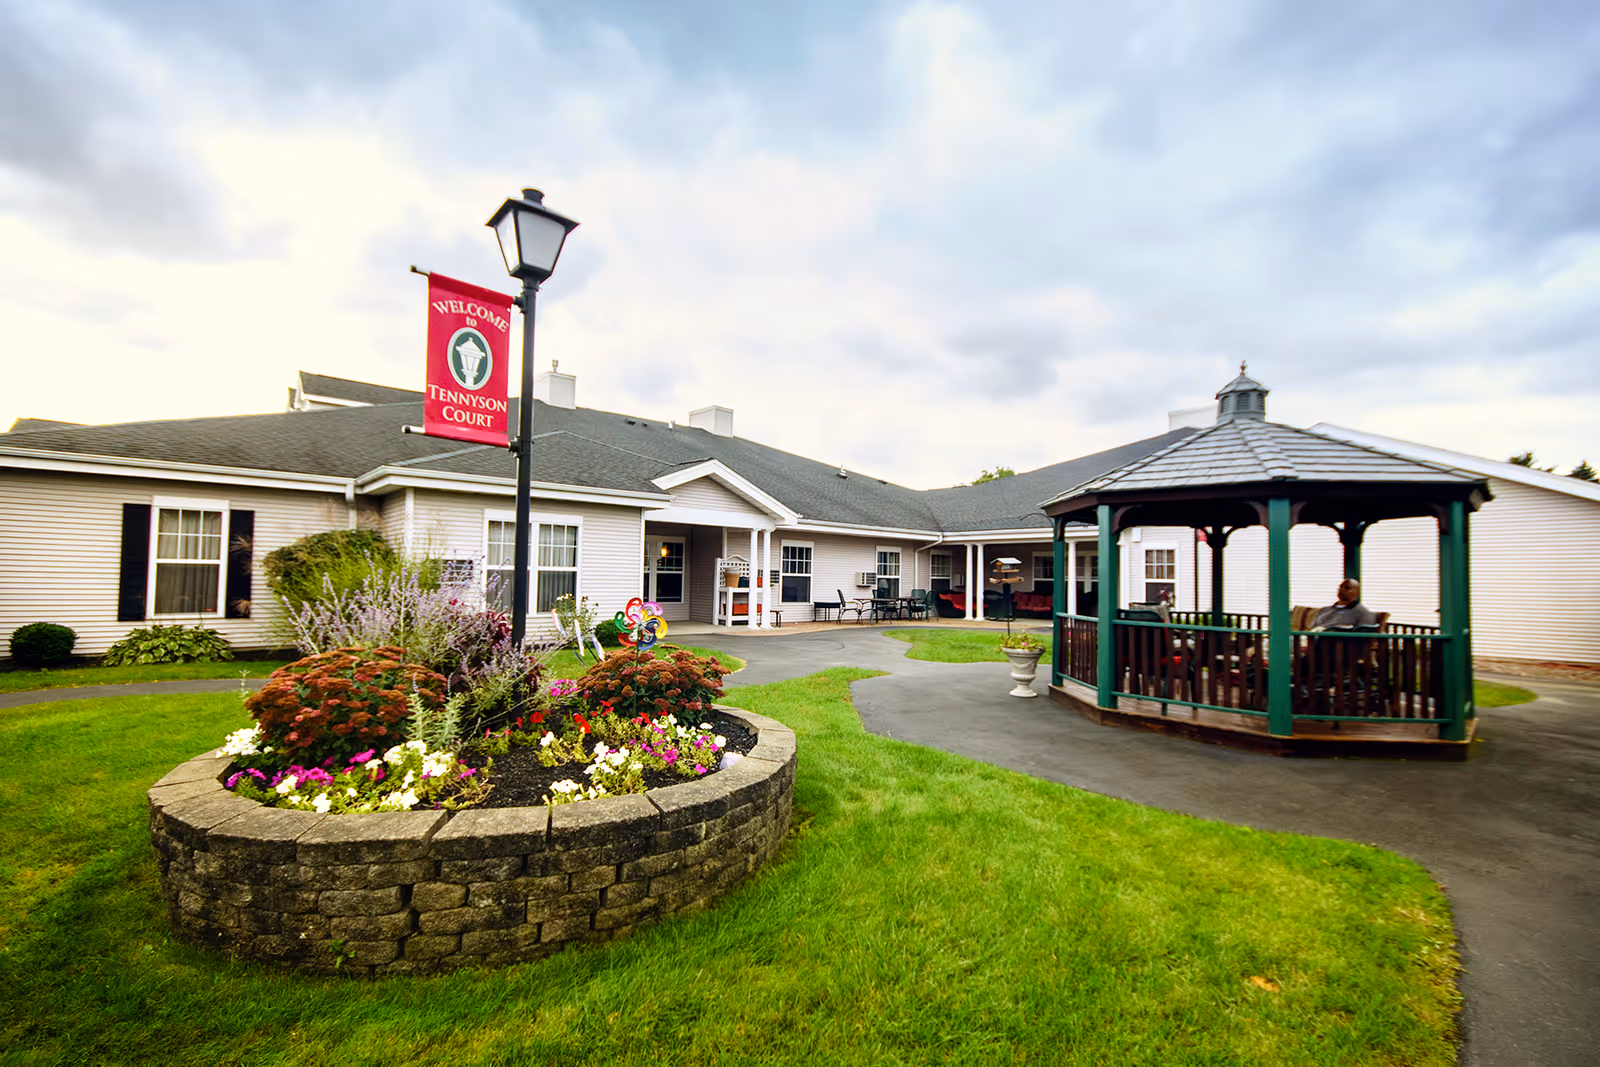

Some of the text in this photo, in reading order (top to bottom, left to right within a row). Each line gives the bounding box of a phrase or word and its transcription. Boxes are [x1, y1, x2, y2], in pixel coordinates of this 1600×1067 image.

[432, 300, 509, 333] WELCOME
[466, 316, 477, 327] to
[428, 384, 507, 413] TENNYSON
[442, 406, 494, 427] COURT
